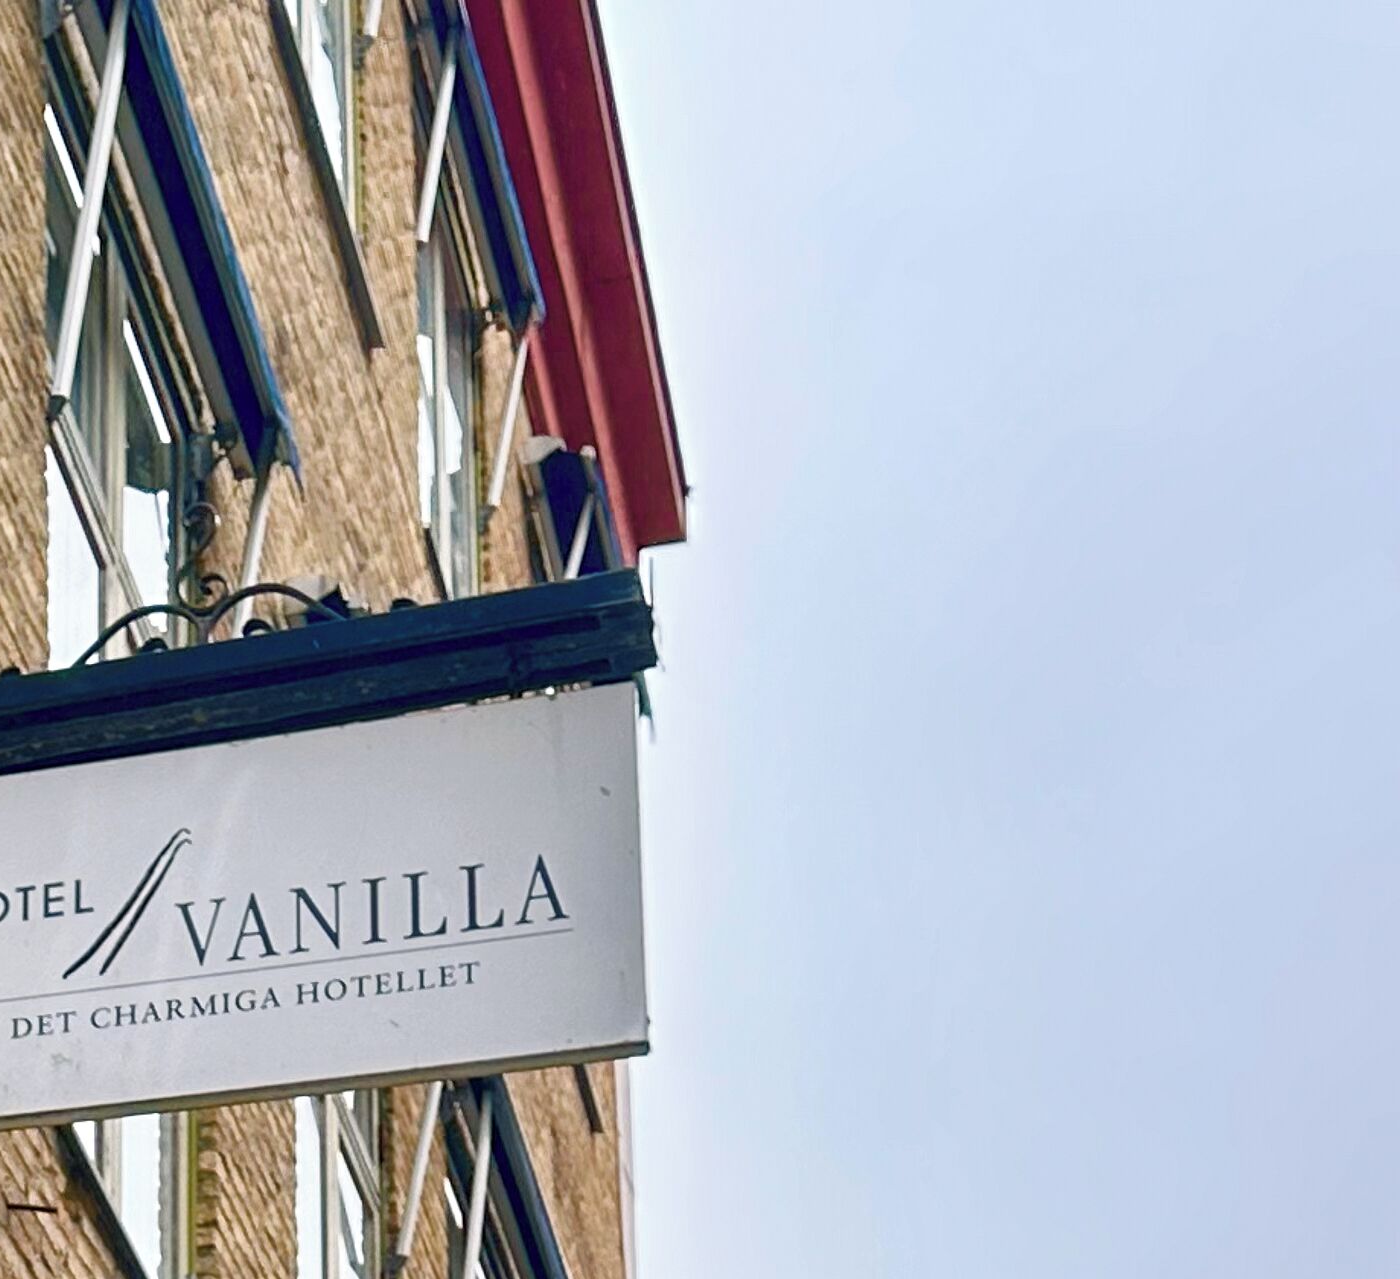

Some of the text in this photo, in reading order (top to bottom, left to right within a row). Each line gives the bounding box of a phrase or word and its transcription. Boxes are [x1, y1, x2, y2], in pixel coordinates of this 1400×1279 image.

[175, 854, 569, 967] VANILLA
[11, 961, 481, 1039] DET CHARMIGA HOTELLET
